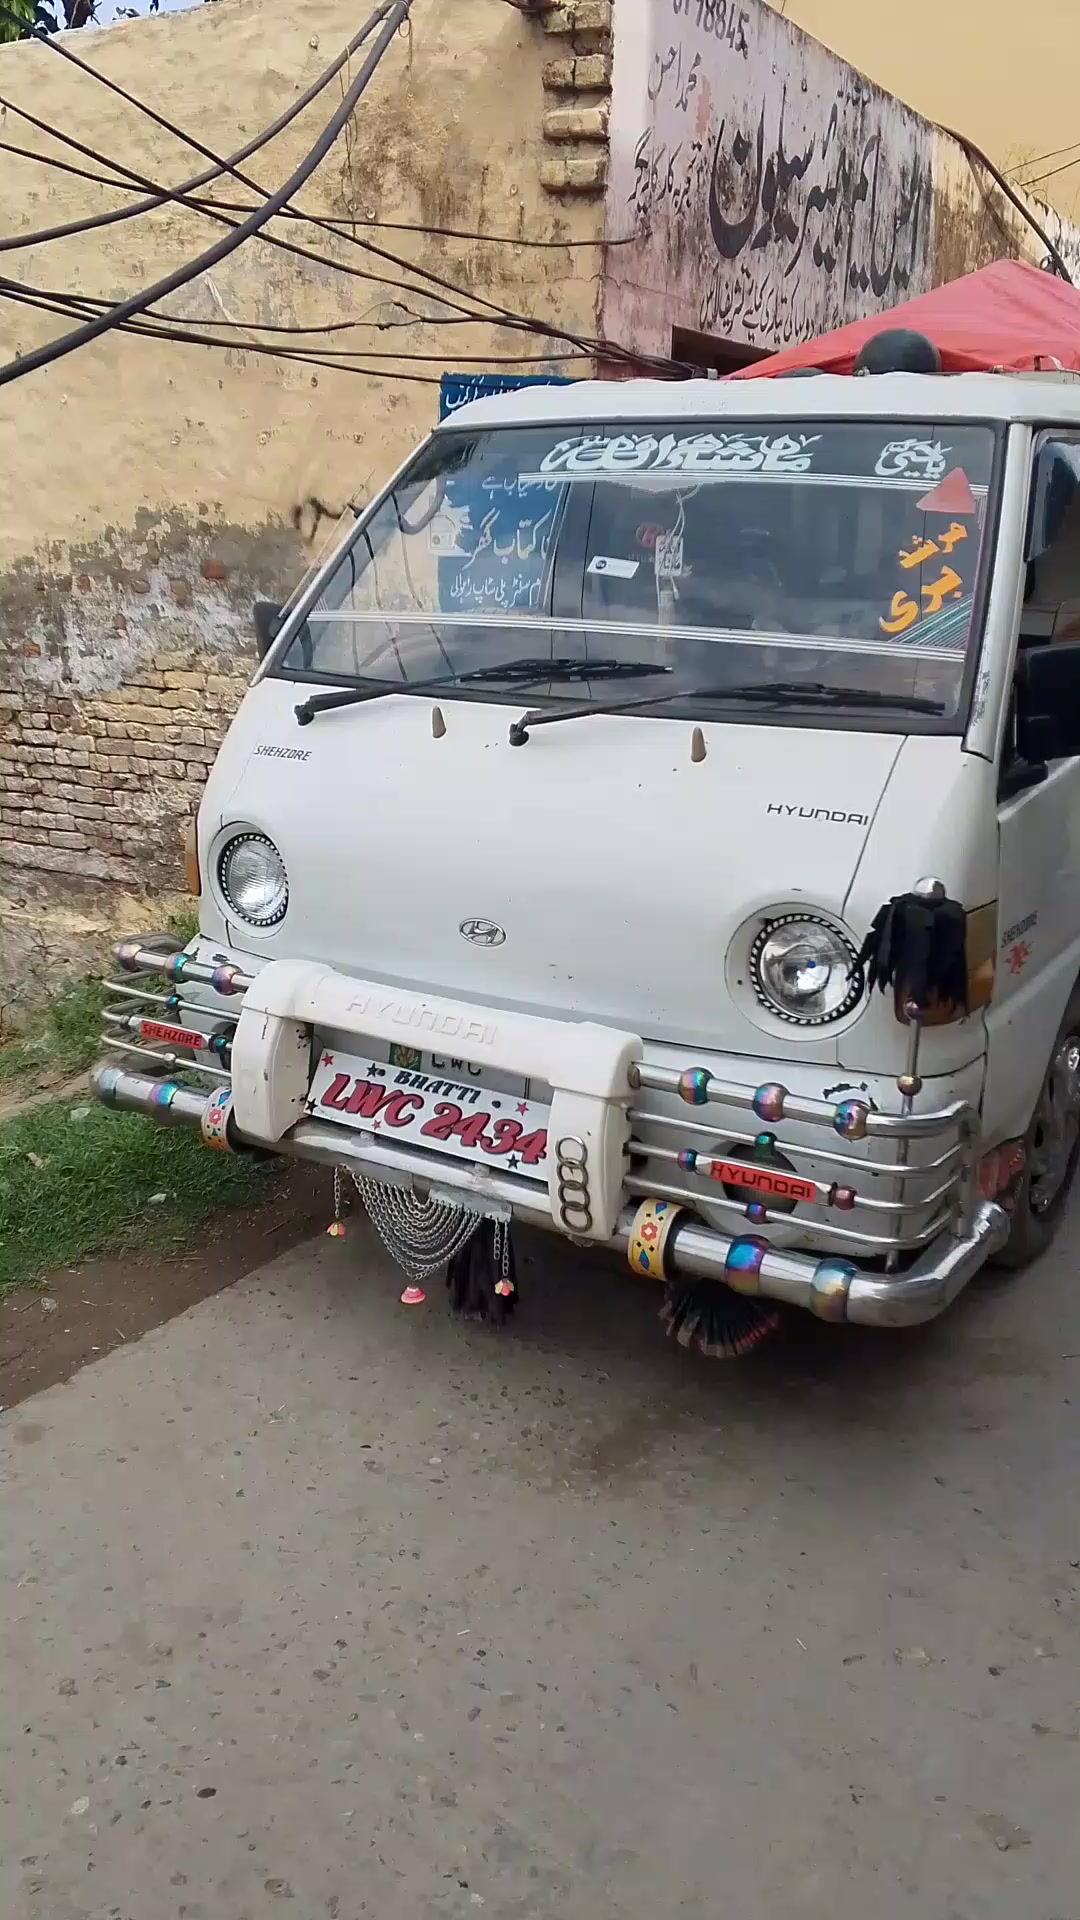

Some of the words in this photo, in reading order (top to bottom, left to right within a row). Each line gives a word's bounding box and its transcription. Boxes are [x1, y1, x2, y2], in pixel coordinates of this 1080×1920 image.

[461, 507, 501, 571] گھر
[493, 508, 553, 565] کتاب
[899, 522, 968, 569] مرشد
[252, 745, 313, 762] SHEHZORE
[766, 803, 869, 826] HYUNDAI
[141, 1022, 202, 1047] SHEHZORE
[346, 995, 499, 1045] HYUNDAI
[393, 1069, 482, 1104] BHATTI
[320, 1072, 425, 1128] LWC
[420, 1102, 548, 1165] 2434
[710, 1161, 812, 1200] HYUNDAI
